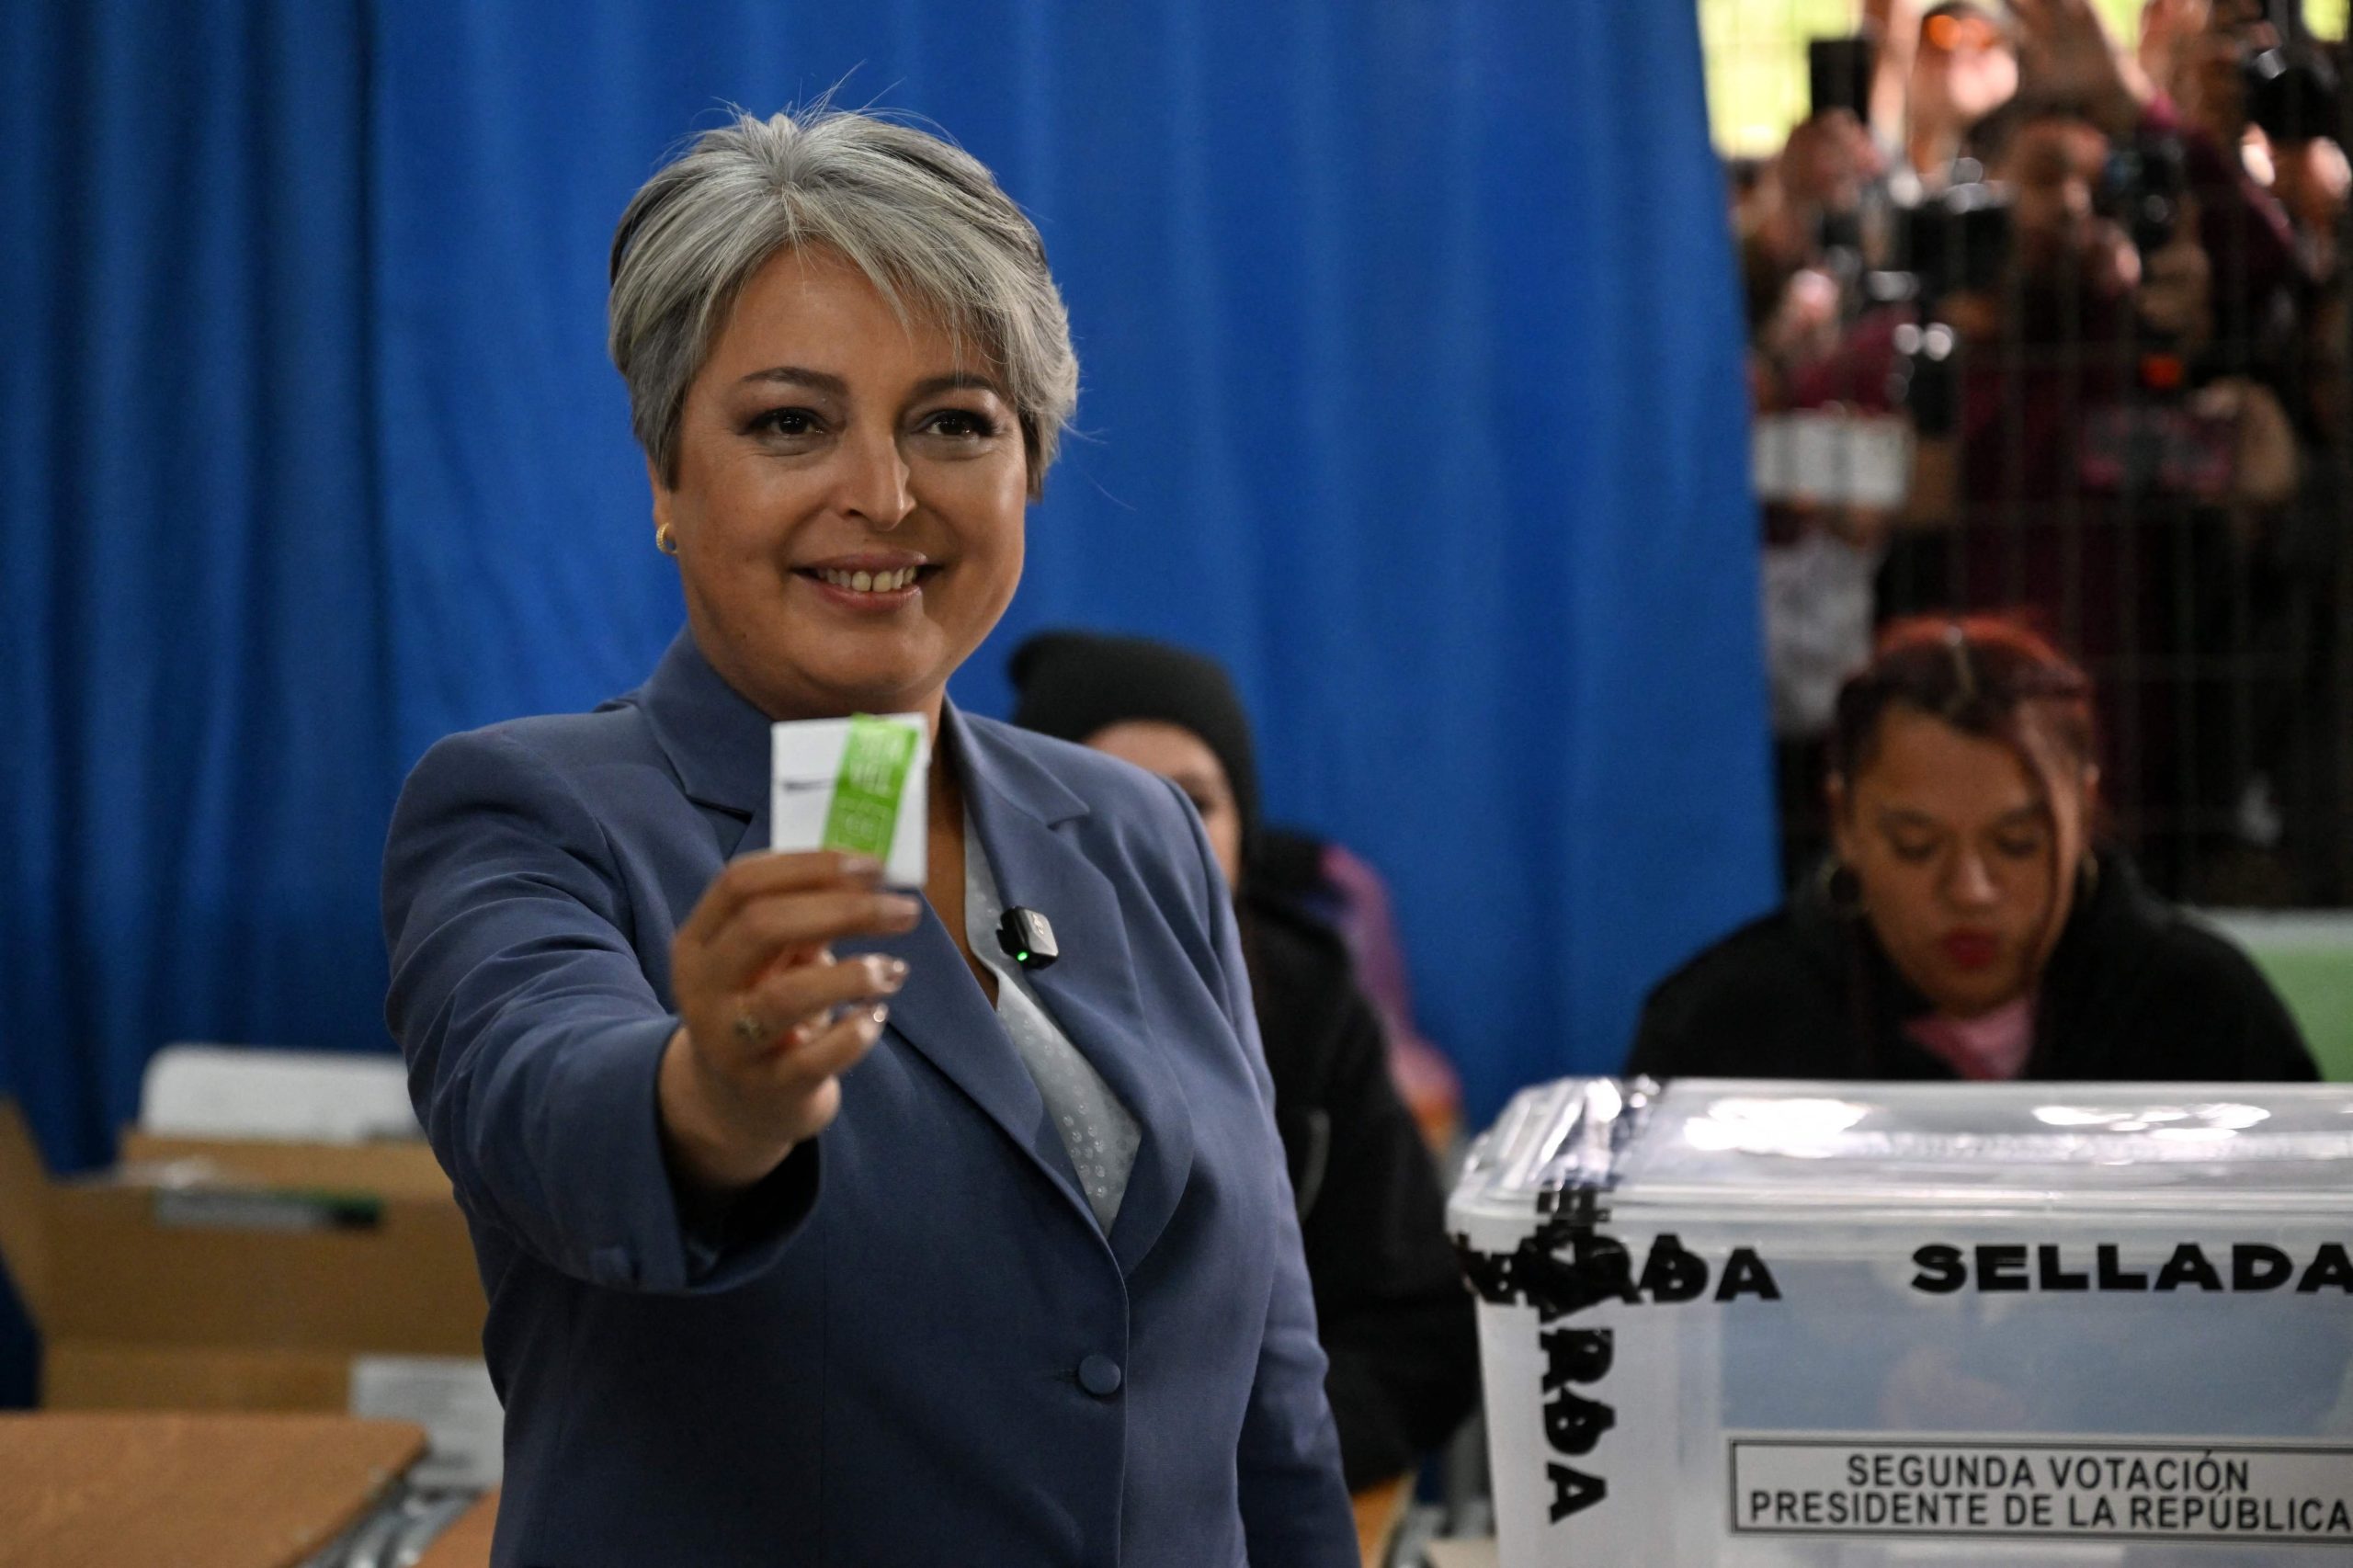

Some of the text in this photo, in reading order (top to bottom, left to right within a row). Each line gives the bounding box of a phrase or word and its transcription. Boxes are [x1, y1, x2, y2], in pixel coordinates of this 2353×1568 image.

[1911, 1243, 2353, 1293] SELLADA
[1847, 1449, 2248, 1493] SEGUNDA VOTACIÓN
[1750, 1486, 2352, 1532] PRESIDENTE DE LA REPÚBLICA
